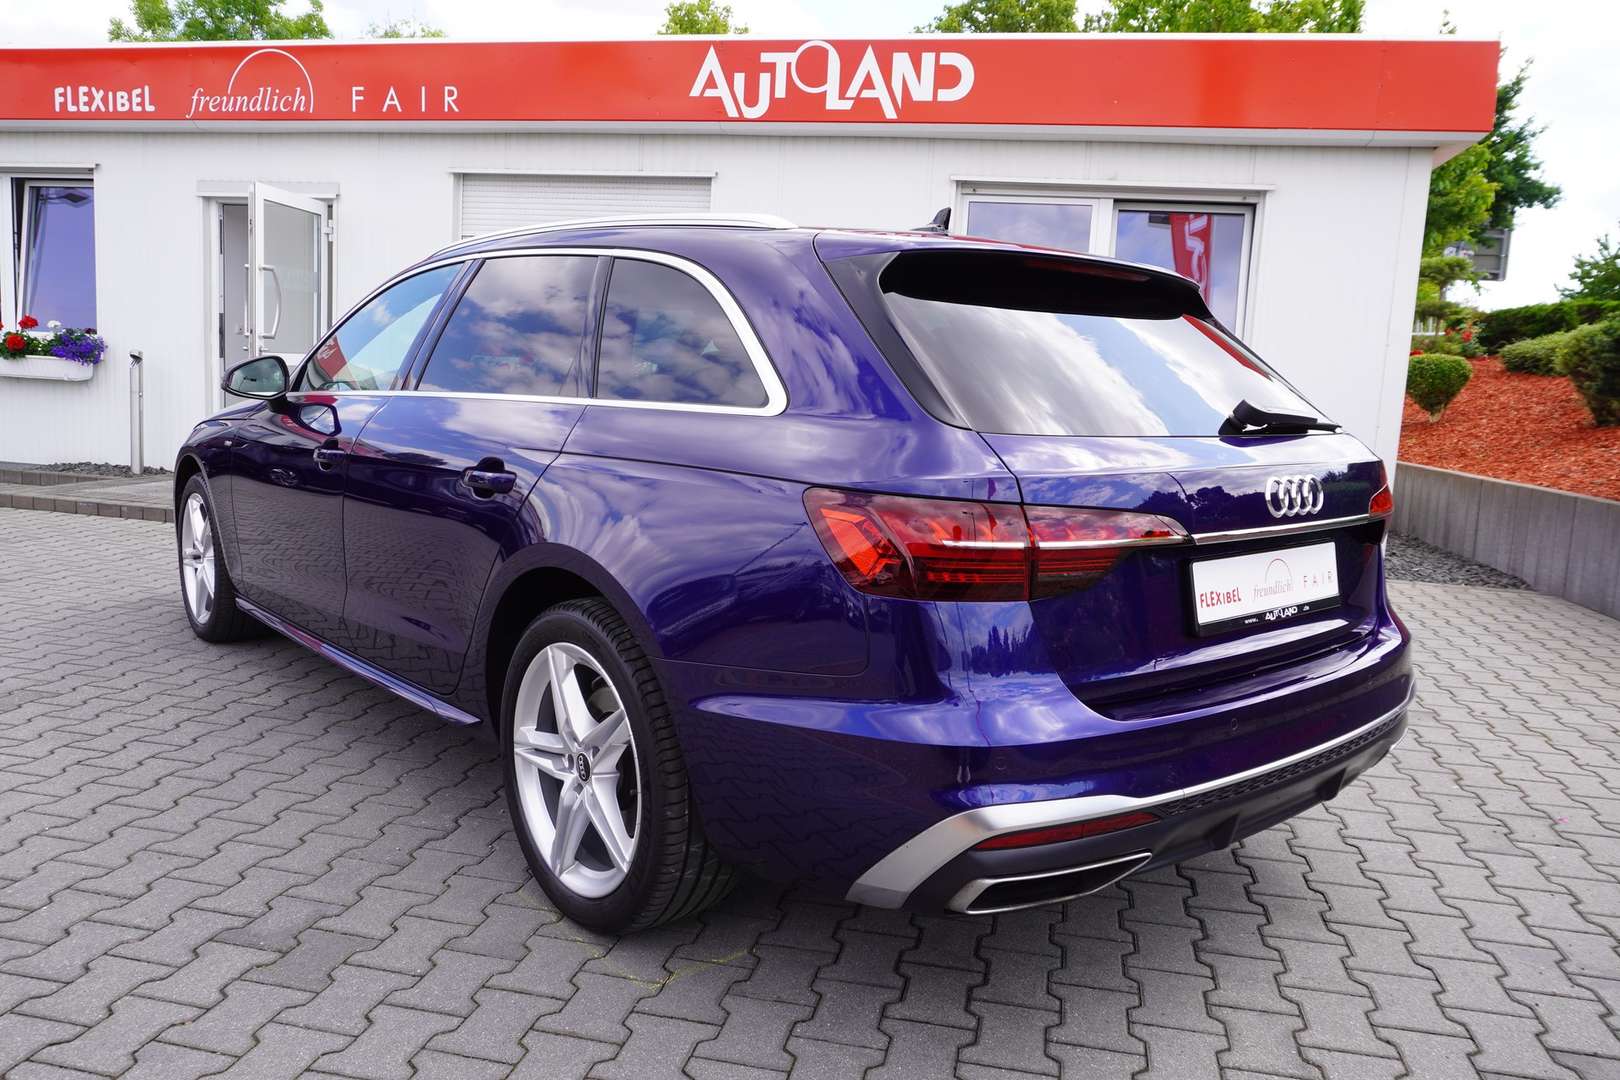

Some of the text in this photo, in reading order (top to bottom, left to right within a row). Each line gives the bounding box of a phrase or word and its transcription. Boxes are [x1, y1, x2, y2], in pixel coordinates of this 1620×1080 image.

[689, 40, 975, 119] AUTOLAND
[54, 85, 460, 117] FLEXIBEL freundlich FAIR
[1200, 587, 1241, 608] FLEXIBEL
